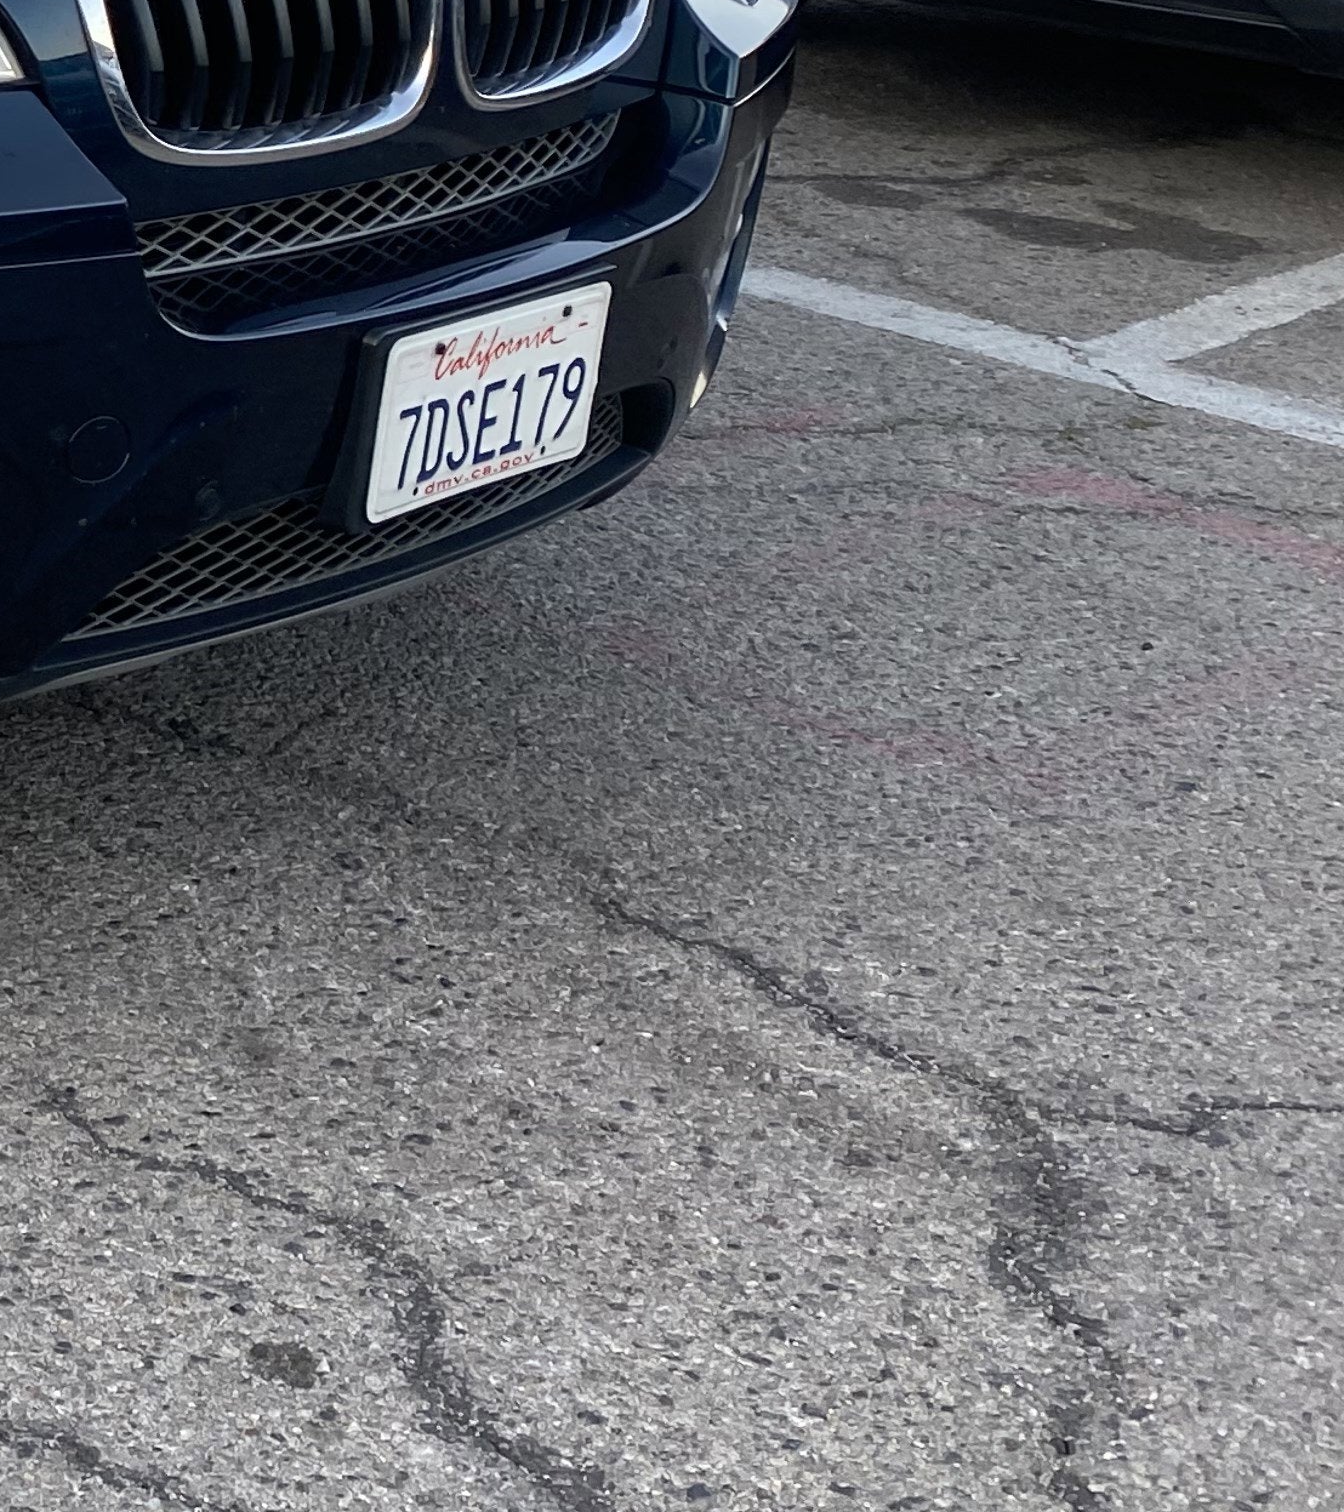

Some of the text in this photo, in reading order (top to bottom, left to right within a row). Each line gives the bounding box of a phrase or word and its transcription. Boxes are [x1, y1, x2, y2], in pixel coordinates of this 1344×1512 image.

[433, 326, 567, 381] California
[399, 357, 586, 490] 7DSE179
[423, 451, 535, 496] dmv.ca.gov
